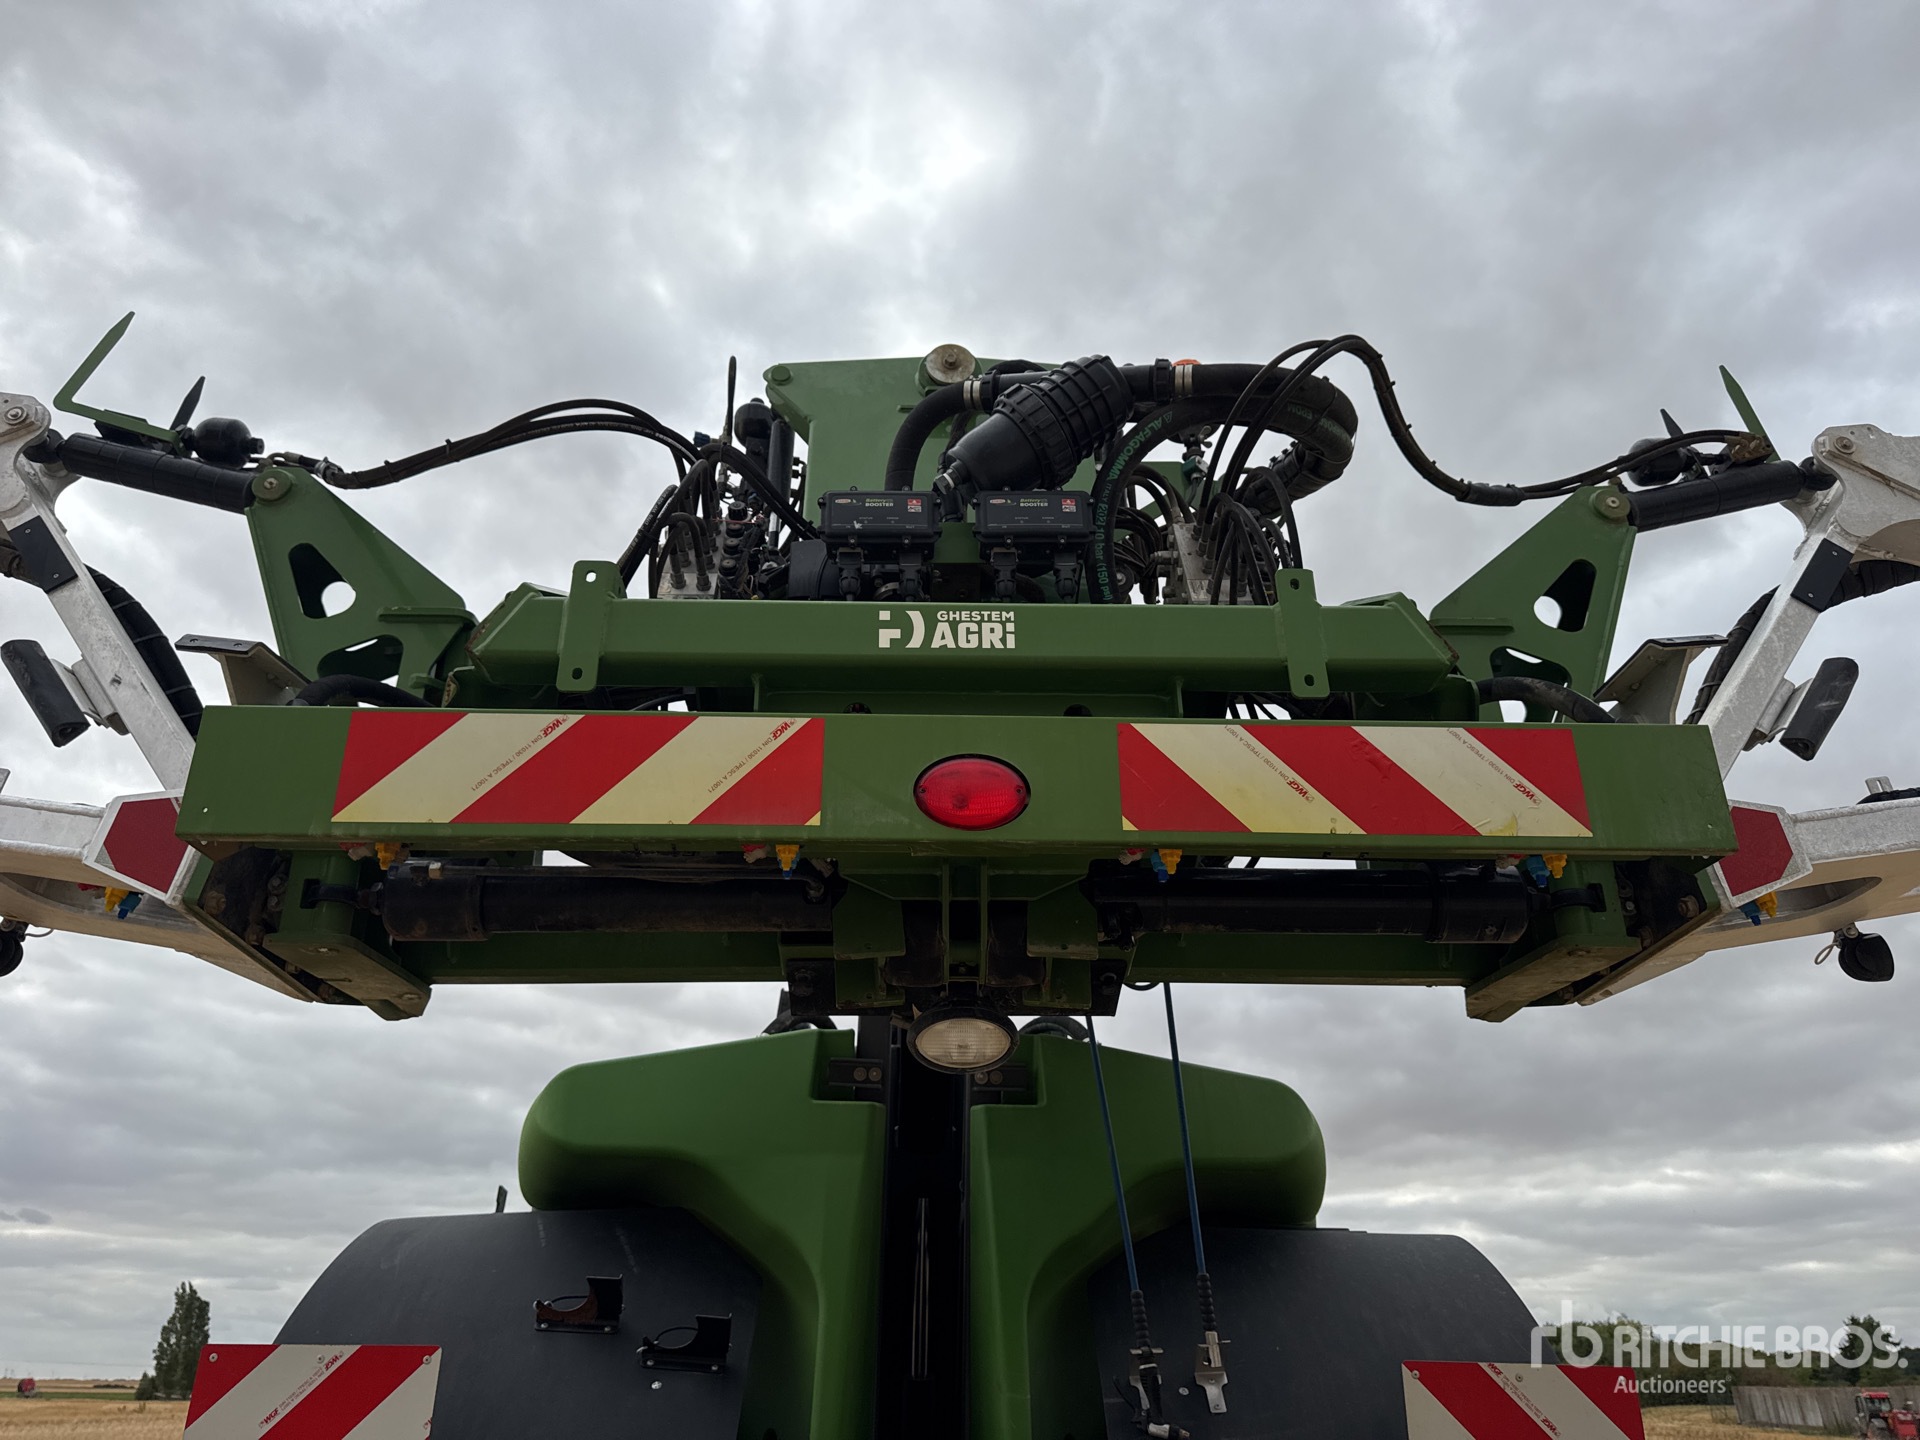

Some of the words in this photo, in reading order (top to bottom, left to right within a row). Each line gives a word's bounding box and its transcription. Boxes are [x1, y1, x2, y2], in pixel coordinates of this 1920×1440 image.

[1107, 417, 1163, 480] ALFAGOMMA
[1102, 484, 1112, 503] ITALY
[1094, 542, 1104, 560] bar
[1096, 563, 1109, 585] (150
[936, 610, 1015, 621] GHESTEM
[541, 718, 562, 736] WGF
[770, 722, 789, 739] WGF
[1224, 724, 1238, 737] 10071
[1446, 727, 1461, 740] 10071
[531, 735, 541, 743] DIN
[762, 737, 771, 746] DIN
[515, 743, 530, 755] 11030
[747, 746, 761, 759] 11030
[1243, 740, 1260, 756] TPESC
[1467, 743, 1484, 759] TPESC
[492, 757, 512, 773] TPESC
[727, 760, 744, 776] TPESC
[1264, 758, 1278, 771] 11030
[1488, 761, 1503, 774] 11030
[1278, 770, 1288, 780] DIN
[1504, 773, 1514, 783] DIN
[471, 777, 487, 790] 10071
[707, 779, 722, 792] 10071
[1287, 777, 1307, 797] WGF
[1513, 780, 1534, 799] WGF
